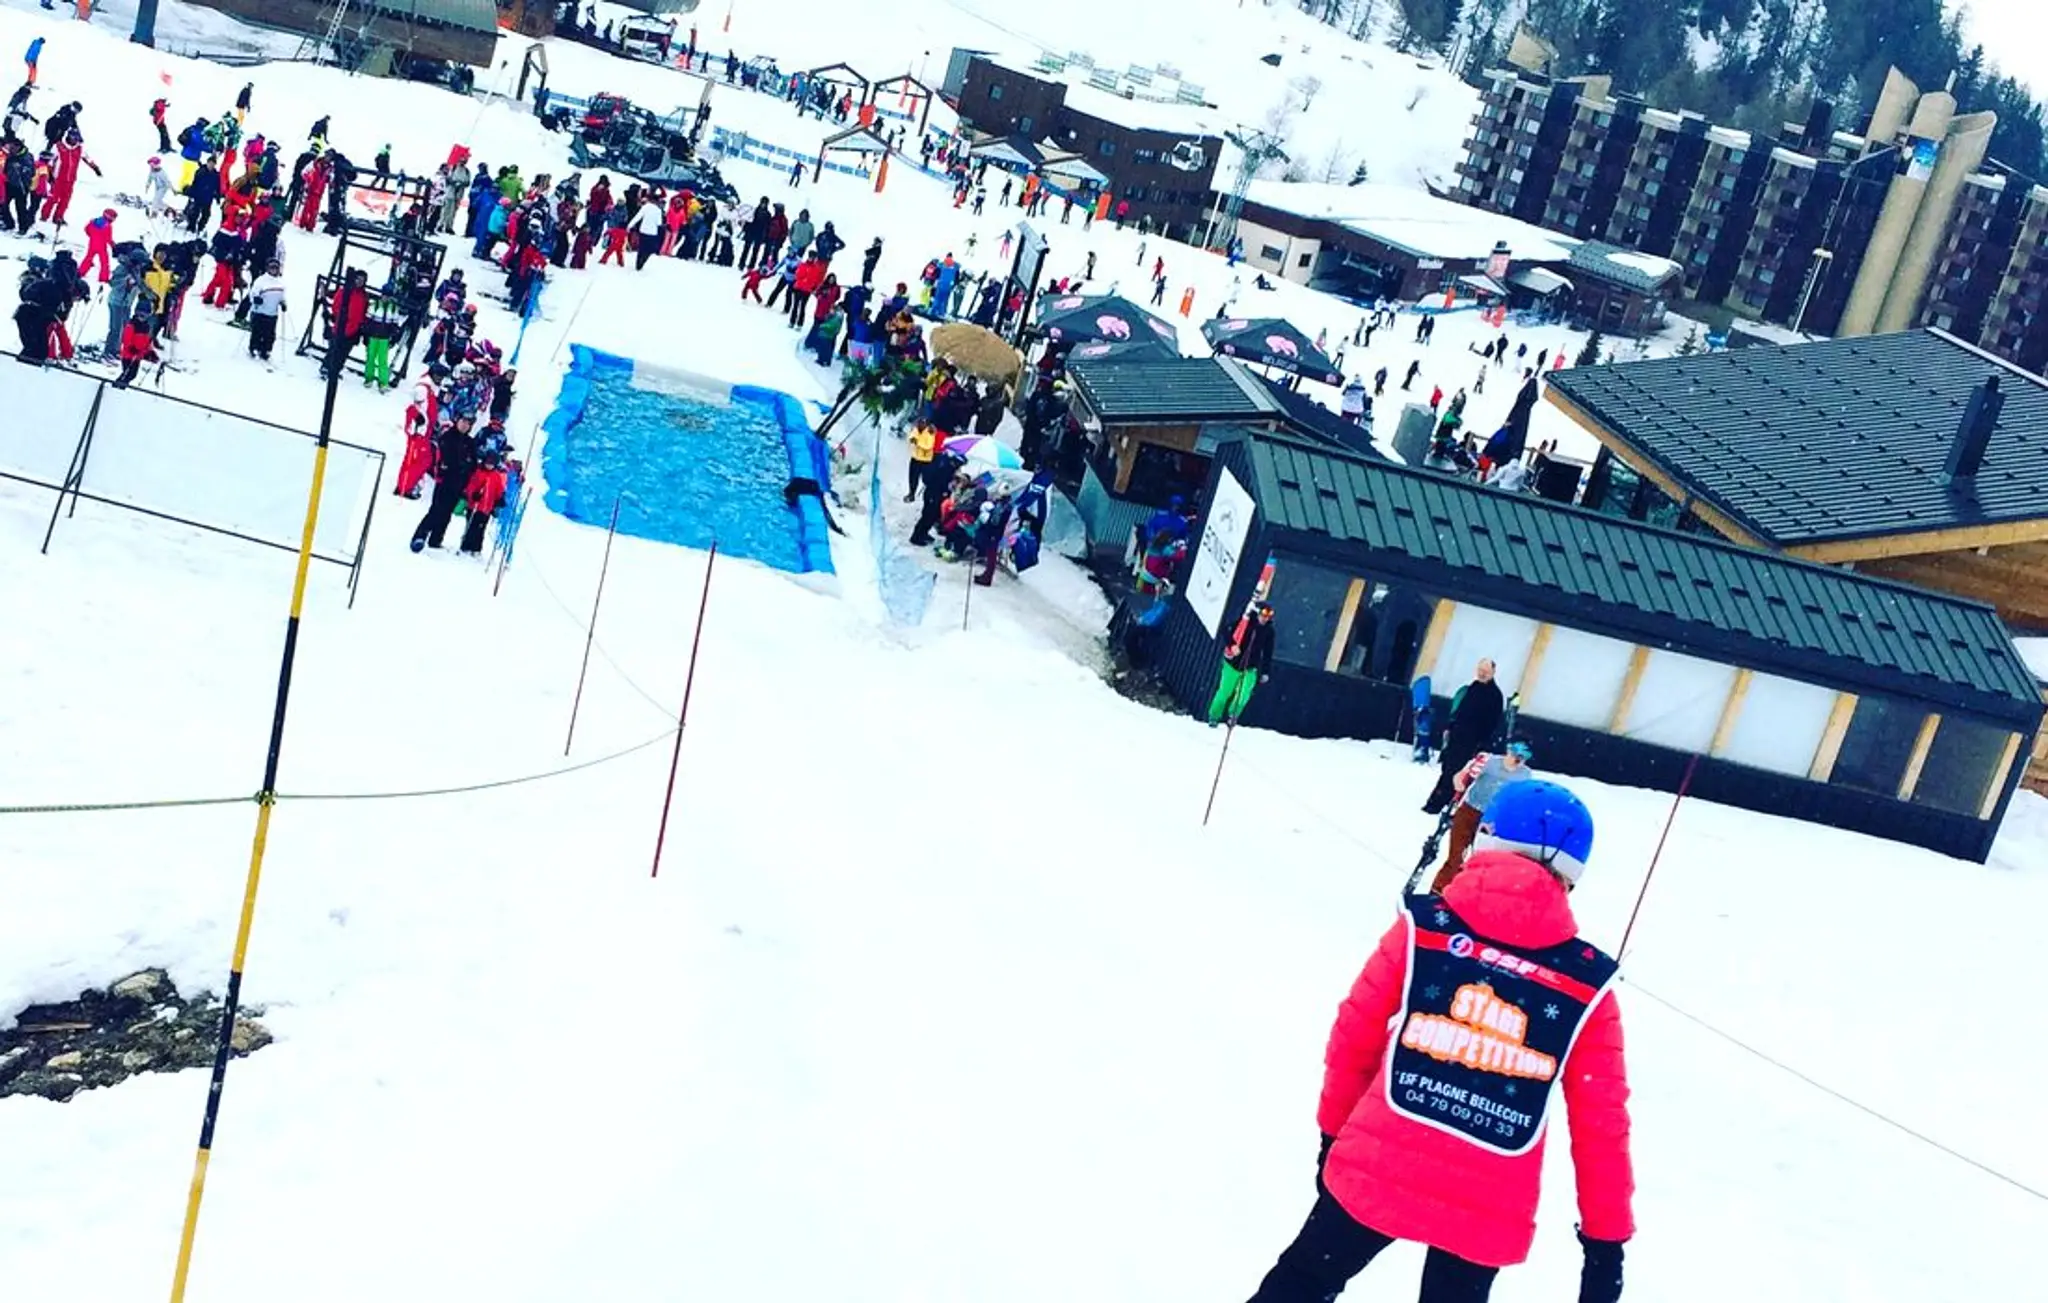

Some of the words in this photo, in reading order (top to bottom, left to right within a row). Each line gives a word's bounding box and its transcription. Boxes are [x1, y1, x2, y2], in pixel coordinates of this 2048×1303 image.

[1454, 988, 1523, 1040] STAGE
[1402, 1016, 1552, 1077] COMPETITION
[1398, 1072, 1419, 1086] ESF
[1419, 1076, 1469, 1104] PLAGNE
[1405, 1089, 1426, 1104] 04
[1430, 1096, 1449, 1112] 79
[1450, 1104, 1472, 1120] 09
[1473, 1113, 1492, 1128] 01
[1494, 1122, 1515, 1138] 33
